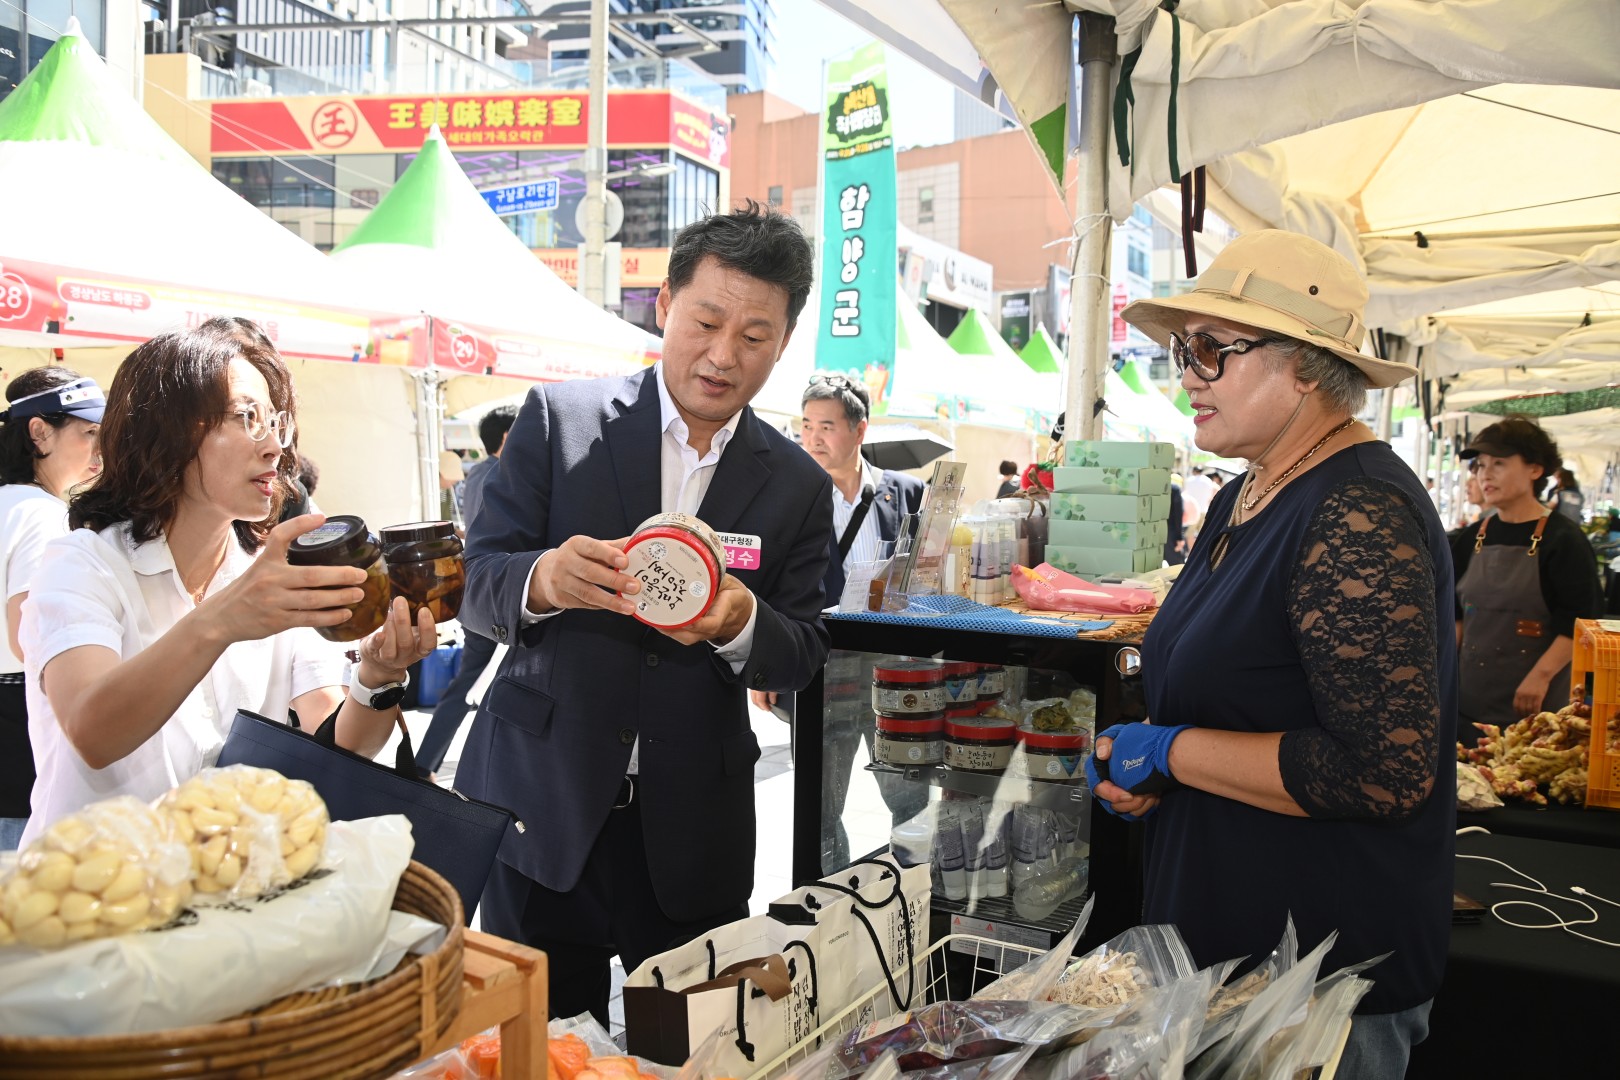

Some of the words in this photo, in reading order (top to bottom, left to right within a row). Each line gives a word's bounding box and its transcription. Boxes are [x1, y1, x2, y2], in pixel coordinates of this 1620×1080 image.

[423, 129, 544, 144] 세대의가족오락관
[831, 183, 871, 338] 함양군
[70, 285, 112, 303] 경상남도
[456, 341, 474, 359] 29
[648, 560, 687, 596] 장아찌
[634, 569, 683, 610] 오만둥이
[967, 750, 996, 761] 오만둥이
[969, 760, 993, 769] 장아찌
